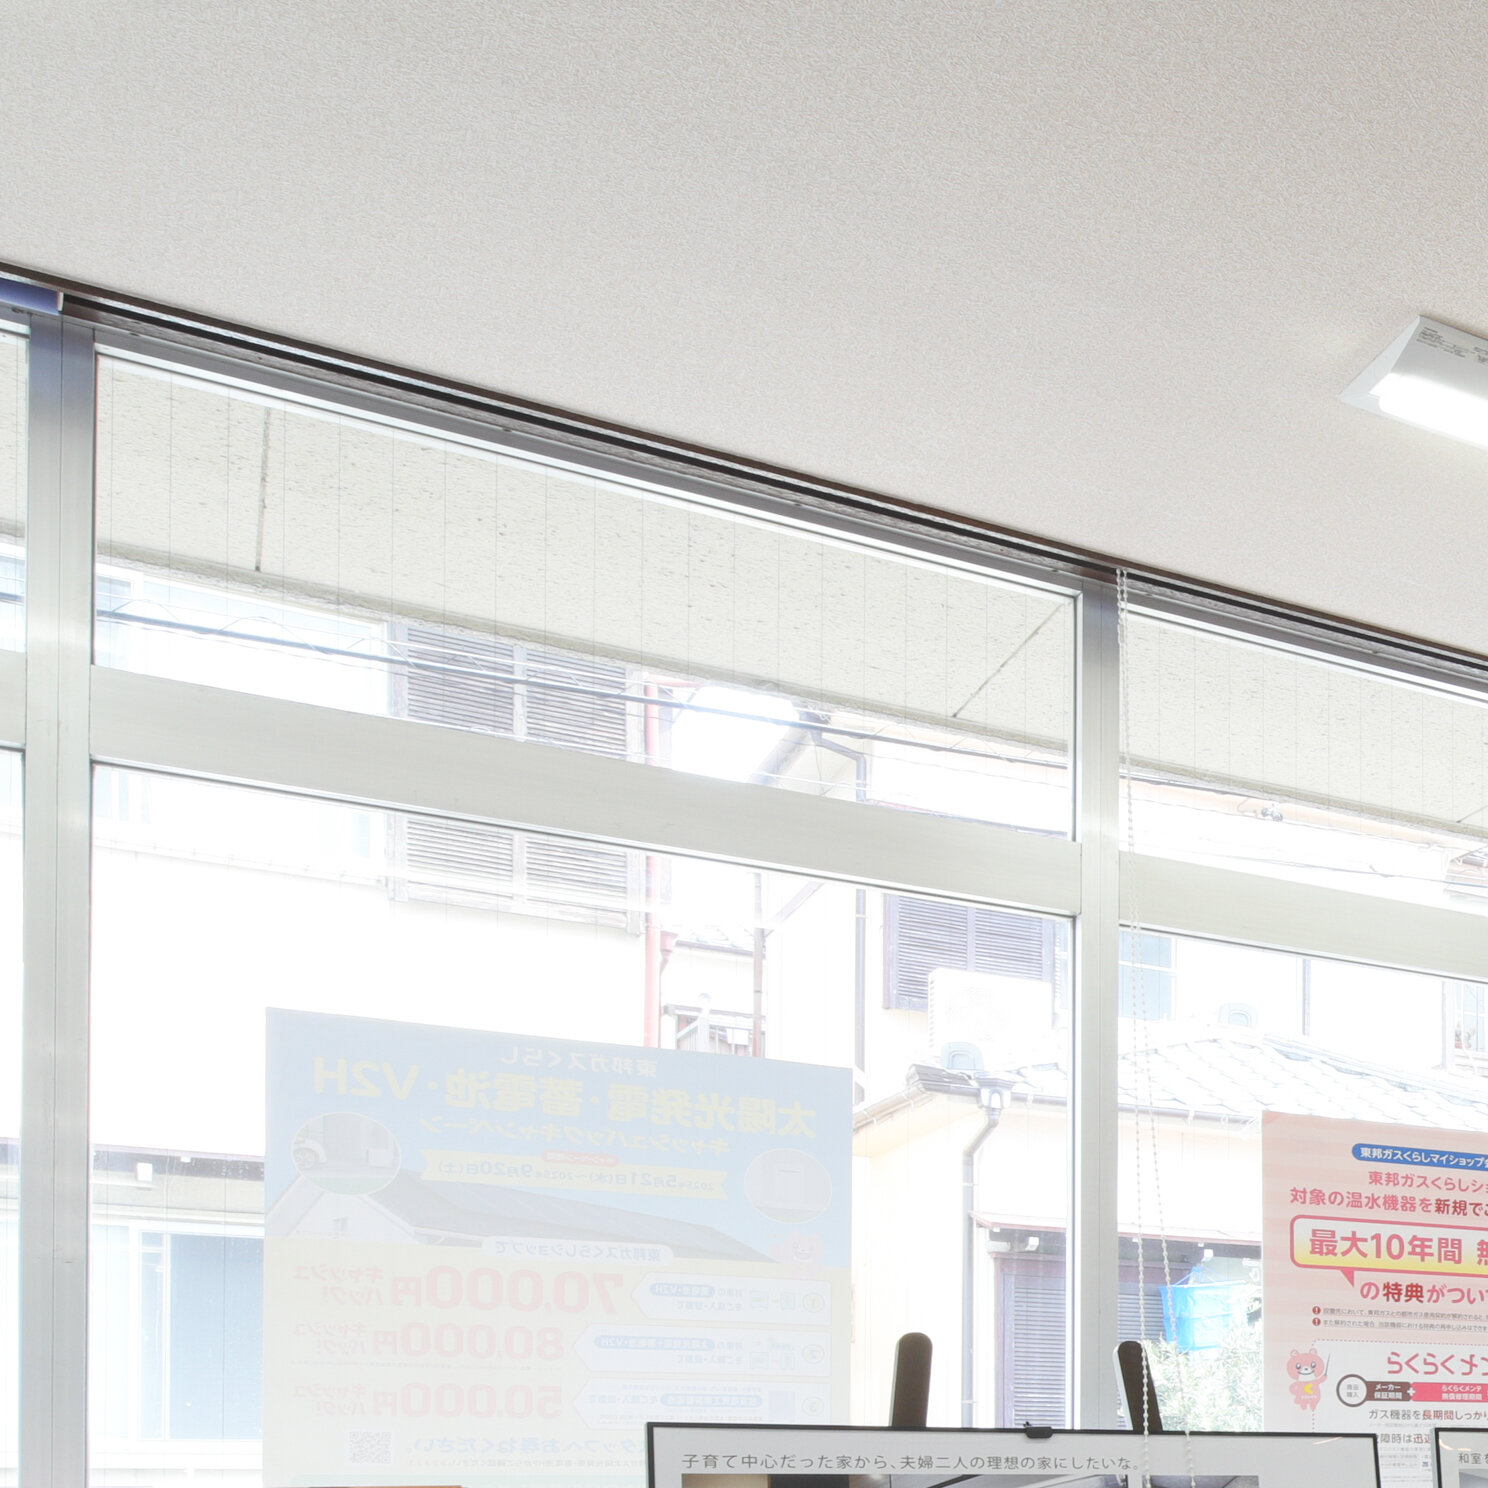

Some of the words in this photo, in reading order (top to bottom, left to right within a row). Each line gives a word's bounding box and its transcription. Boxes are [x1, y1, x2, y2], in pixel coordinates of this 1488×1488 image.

[1309, 1228, 1463, 1265] 最大10年間
[681, 1453, 1140, 1471] 子育て中心だった家から、夫婦二人の理想の家にしたいな。
